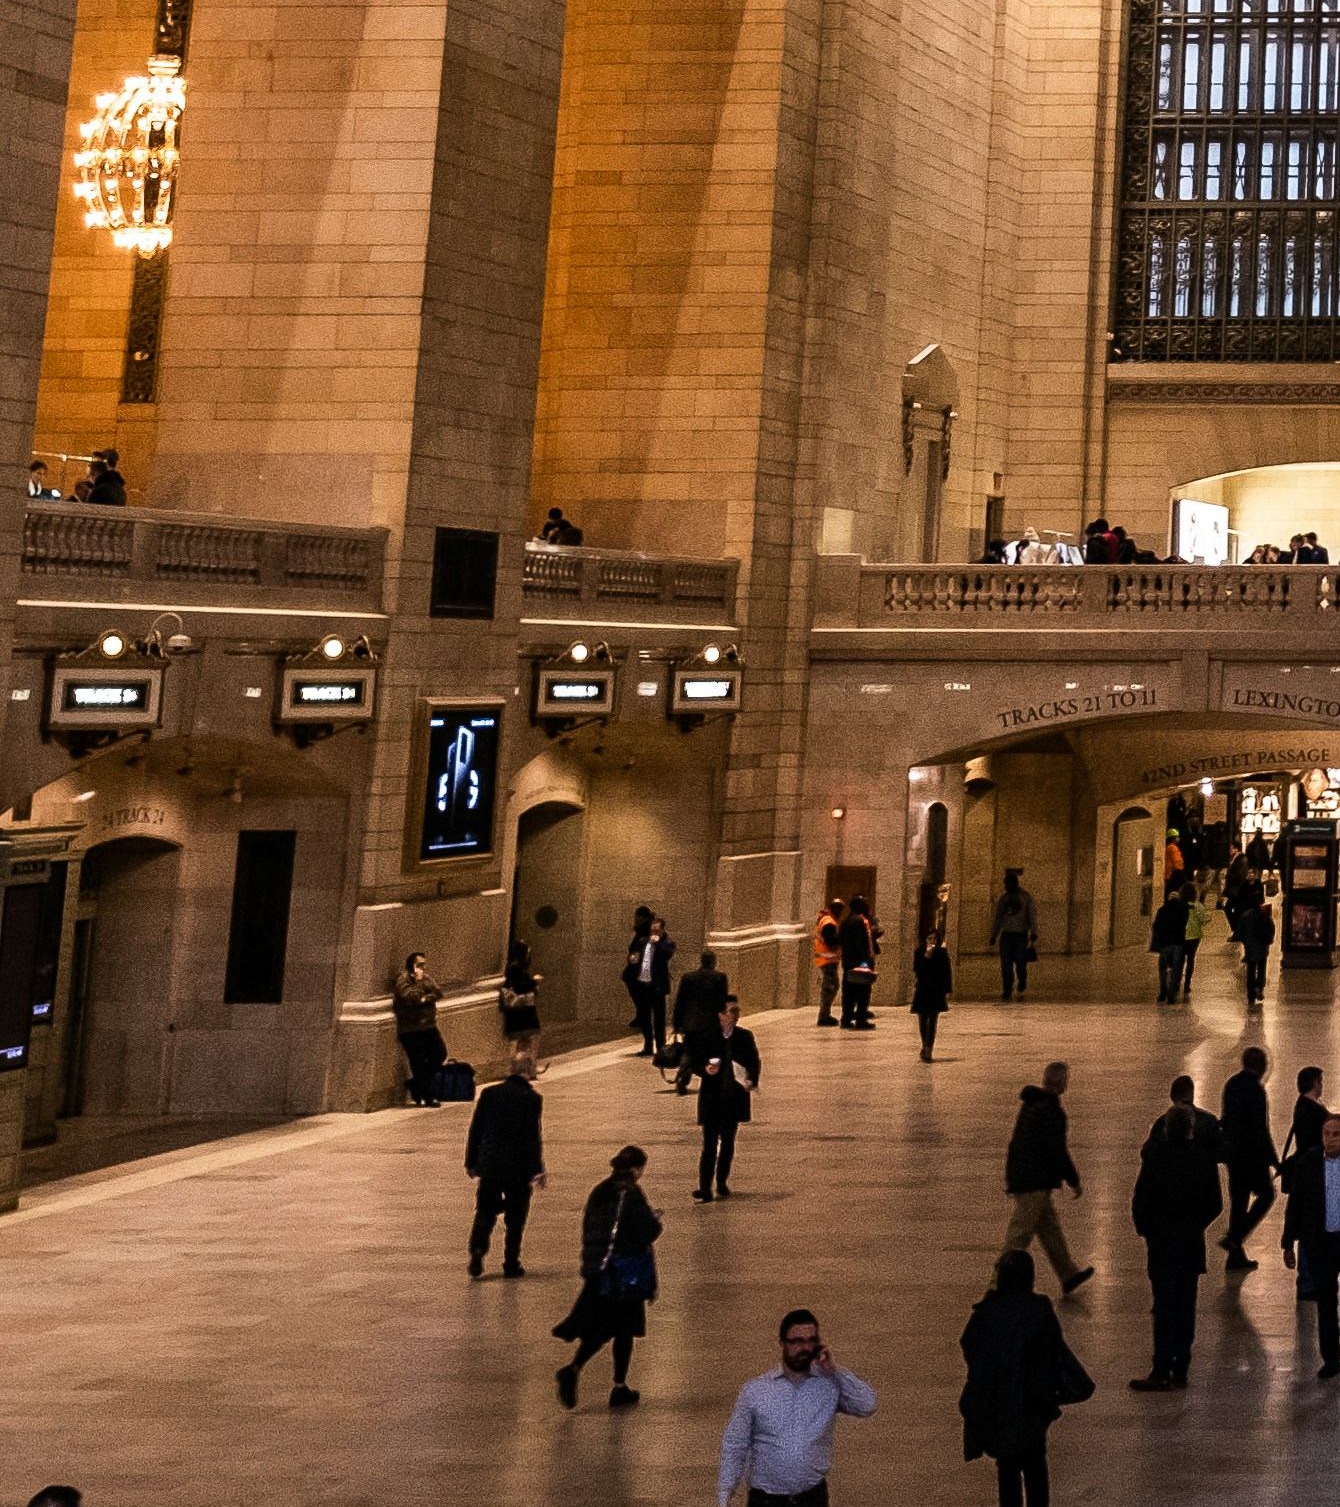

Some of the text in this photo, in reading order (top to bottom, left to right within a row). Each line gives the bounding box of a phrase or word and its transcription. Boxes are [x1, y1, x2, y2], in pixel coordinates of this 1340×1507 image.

[997, 690, 1157, 728] TRACKS 21 TO 11
[1140, 763, 1186, 782] 42ND
[1190, 752, 1253, 773] STREET
[1258, 748, 1330, 764] PASSAGE
